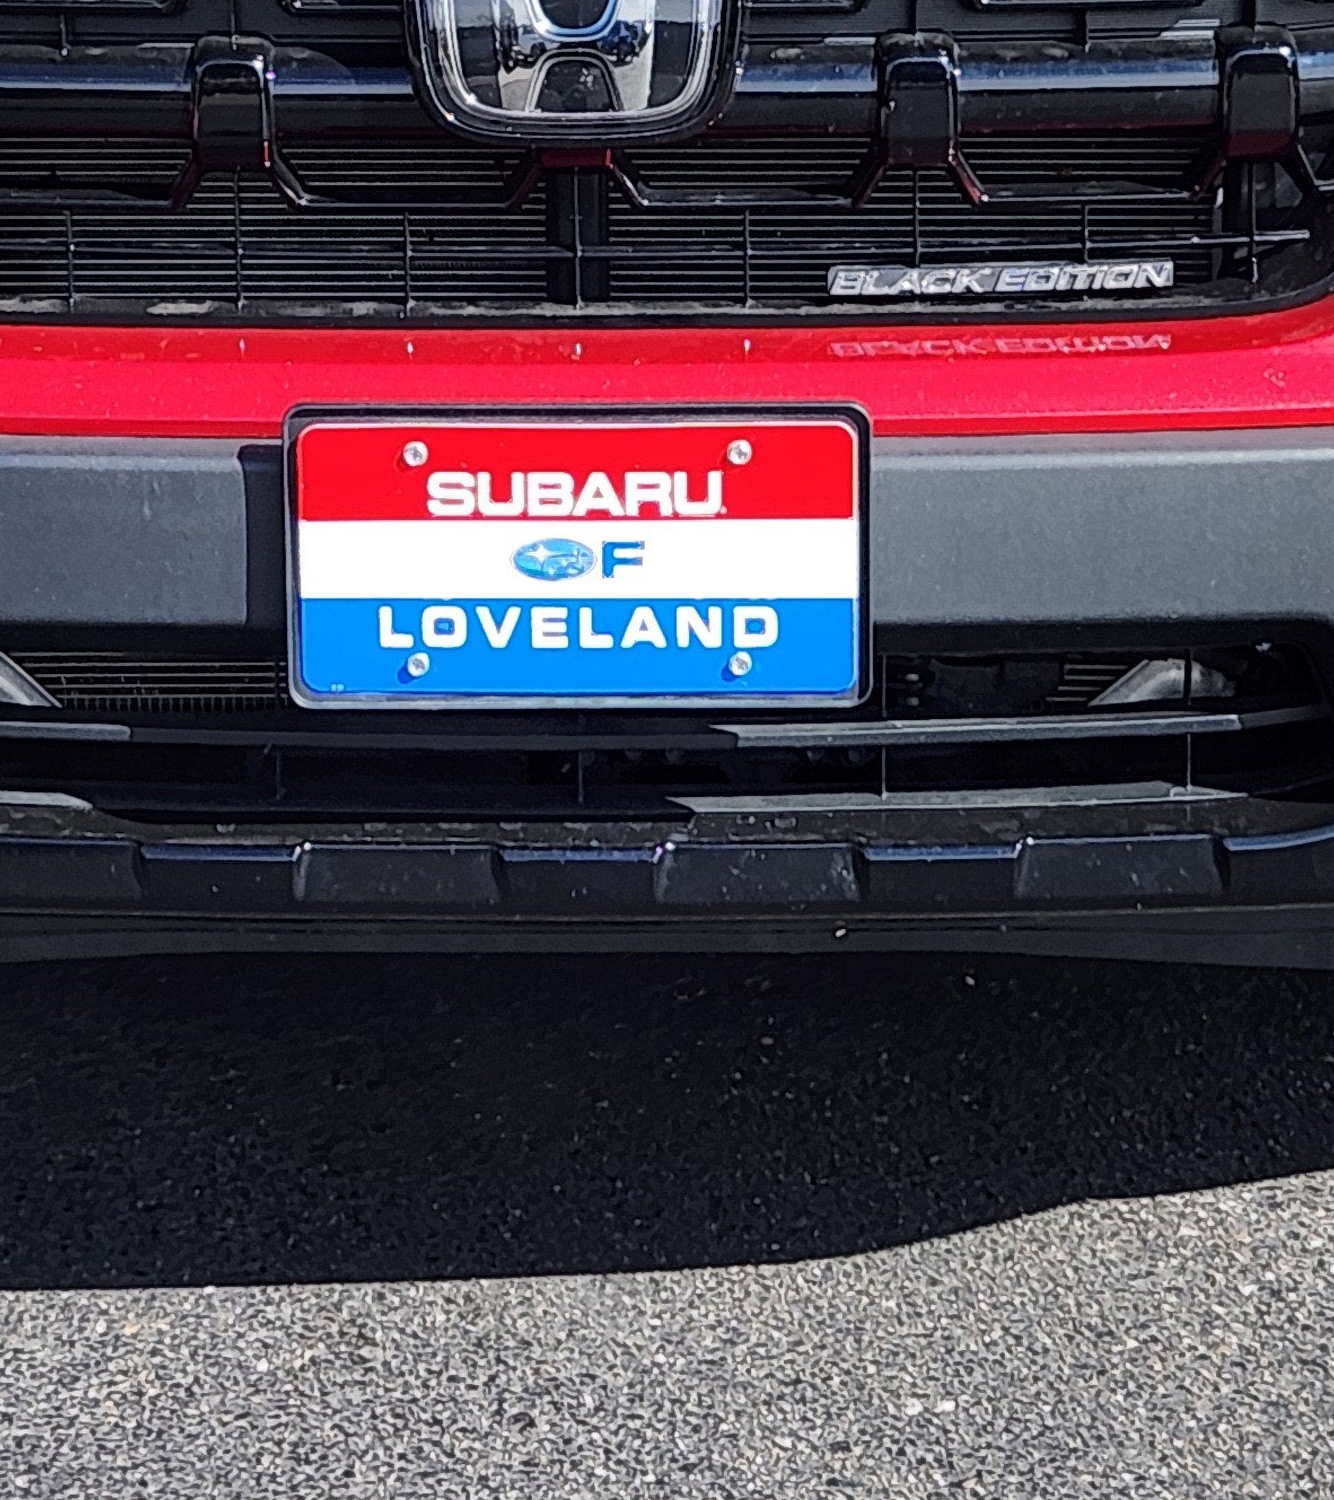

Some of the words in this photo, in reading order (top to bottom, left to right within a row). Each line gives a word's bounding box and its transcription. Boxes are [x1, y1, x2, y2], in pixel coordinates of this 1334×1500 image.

[829, 267, 993, 295] BLACK
[995, 261, 1174, 292] EDITION
[427, 471, 725, 516] SUBARU
[378, 605, 779, 649] LOVELAND
